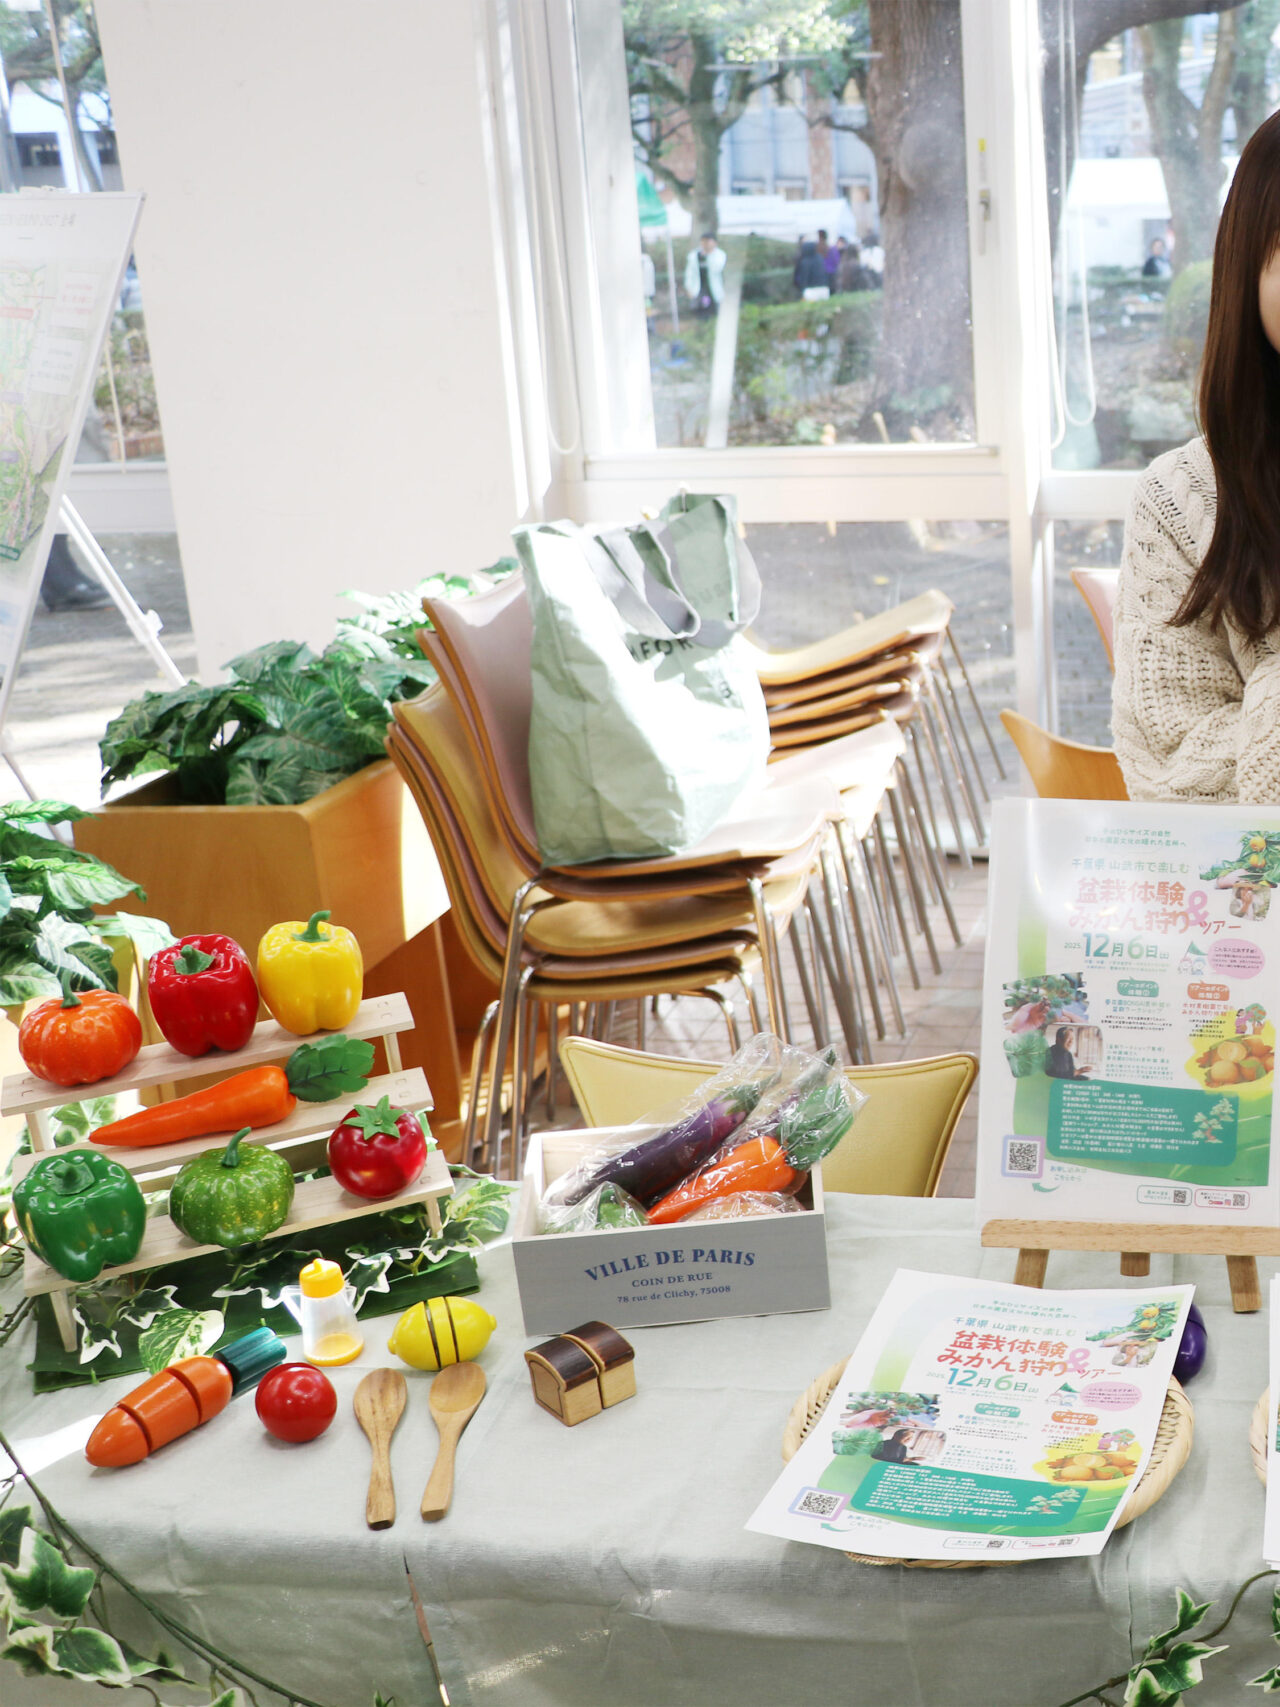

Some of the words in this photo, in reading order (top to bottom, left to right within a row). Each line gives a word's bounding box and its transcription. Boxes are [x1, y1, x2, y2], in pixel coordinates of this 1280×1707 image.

[1076, 877, 1187, 907] 盆栽体験
[1068, 905, 1191, 935] みかん狩り
[1198, 920, 1242, 935] ツアー
[584, 1254, 649, 1281] VILLE
[655, 1249, 685, 1265] DE
[691, 1248, 756, 1266] PARIS
[632, 1277, 664, 1288] COIN
[668, 1275, 685, 1284] DE
[688, 1272, 713, 1282] RUE
[650, 1292, 661, 1300] de
[700, 1285, 731, 1295] 75008
[950, 1330, 1069, 1359] 盆栽体験
[936, 1348, 1068, 1377] みかん狩り
